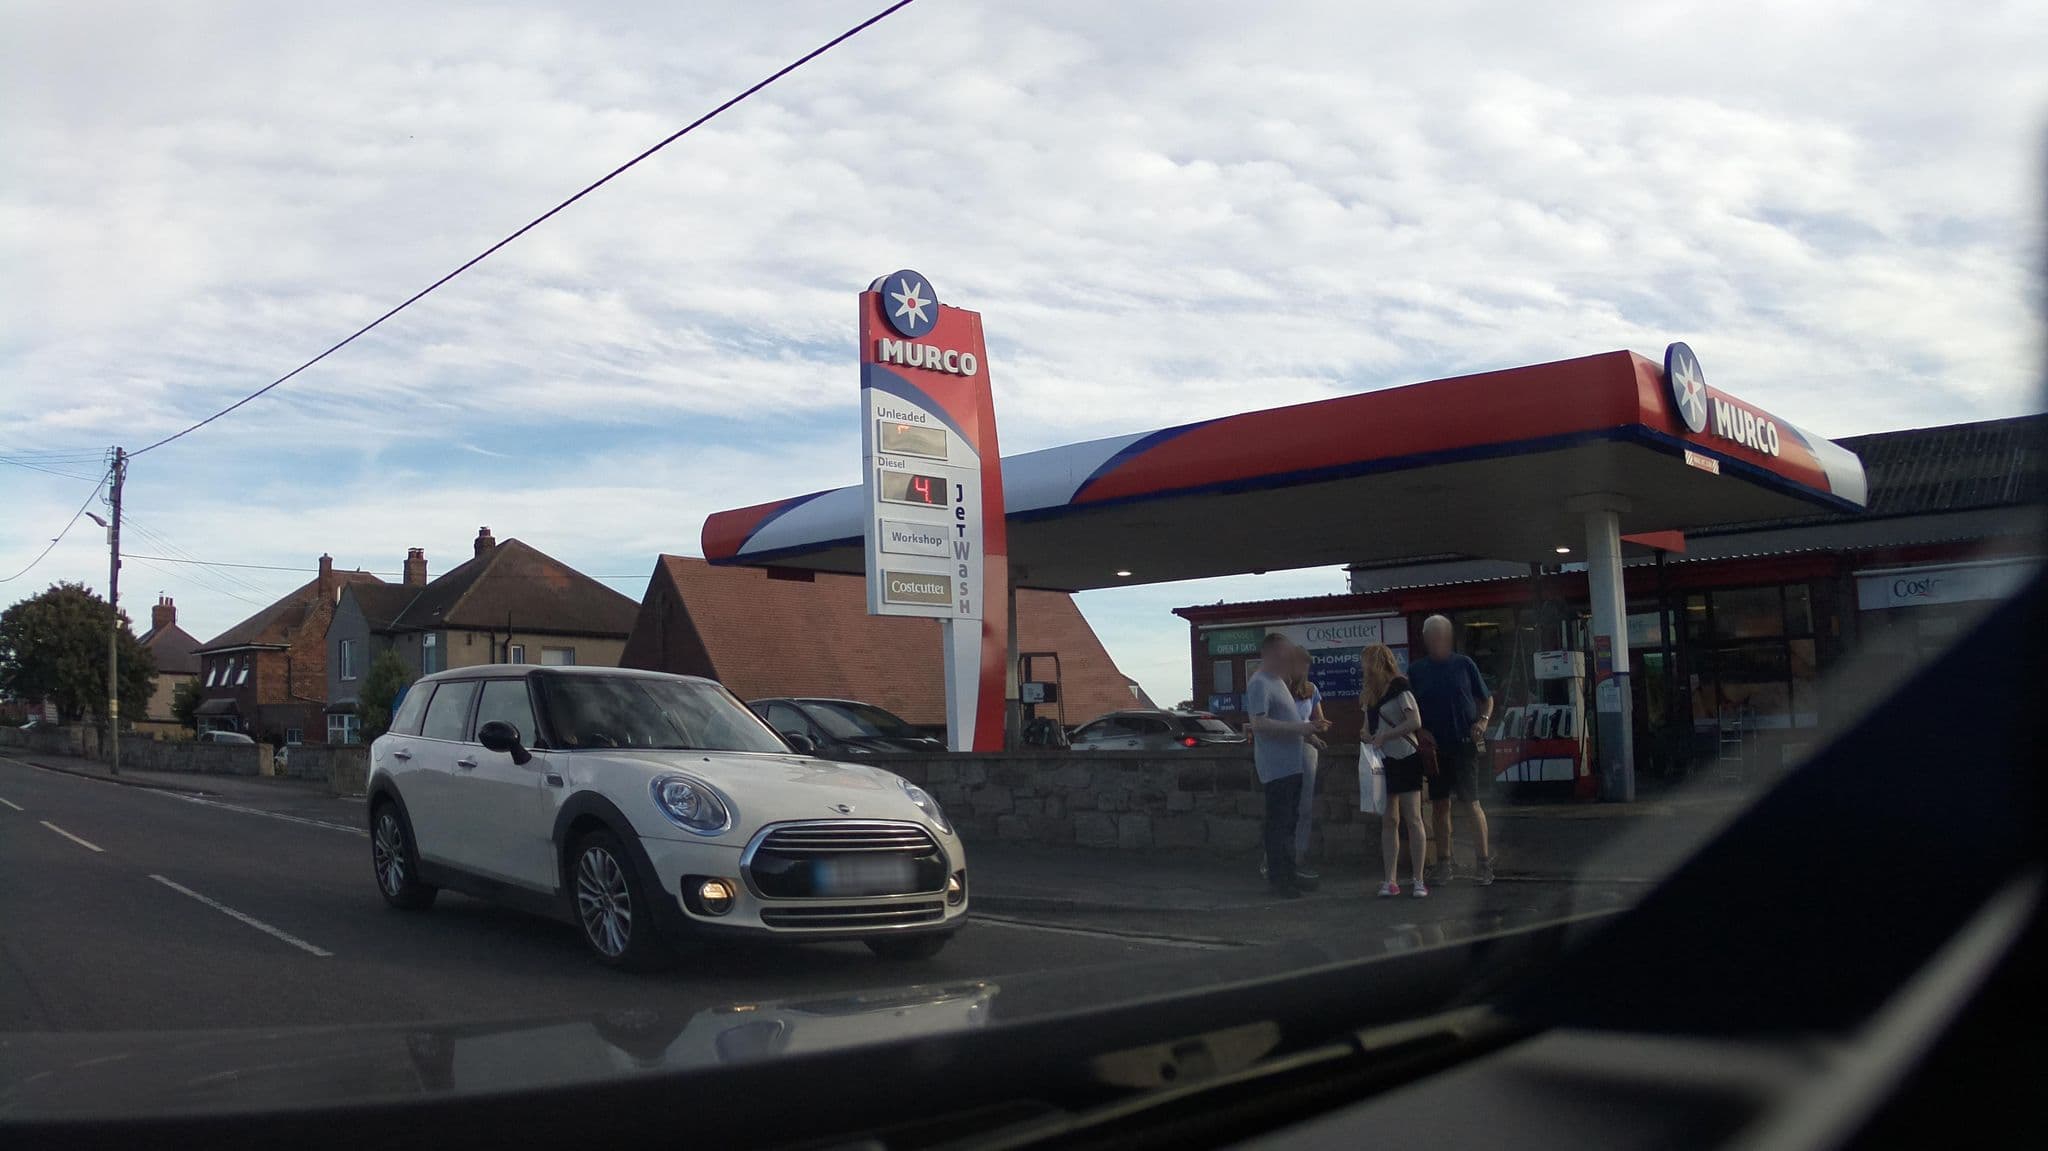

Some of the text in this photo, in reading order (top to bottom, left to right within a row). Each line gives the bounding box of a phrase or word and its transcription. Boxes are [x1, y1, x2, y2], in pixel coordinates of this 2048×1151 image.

[880, 338, 978, 376] MURCO
[877, 406, 926, 423] Unleaded
[1714, 397, 1780, 457] MURCO
[878, 457, 905, 469] Diesel
[891, 531, 943, 547] Workshop
[891, 580, 944, 595] Costcutter
[1306, 623, 1377, 642] Costcutter
